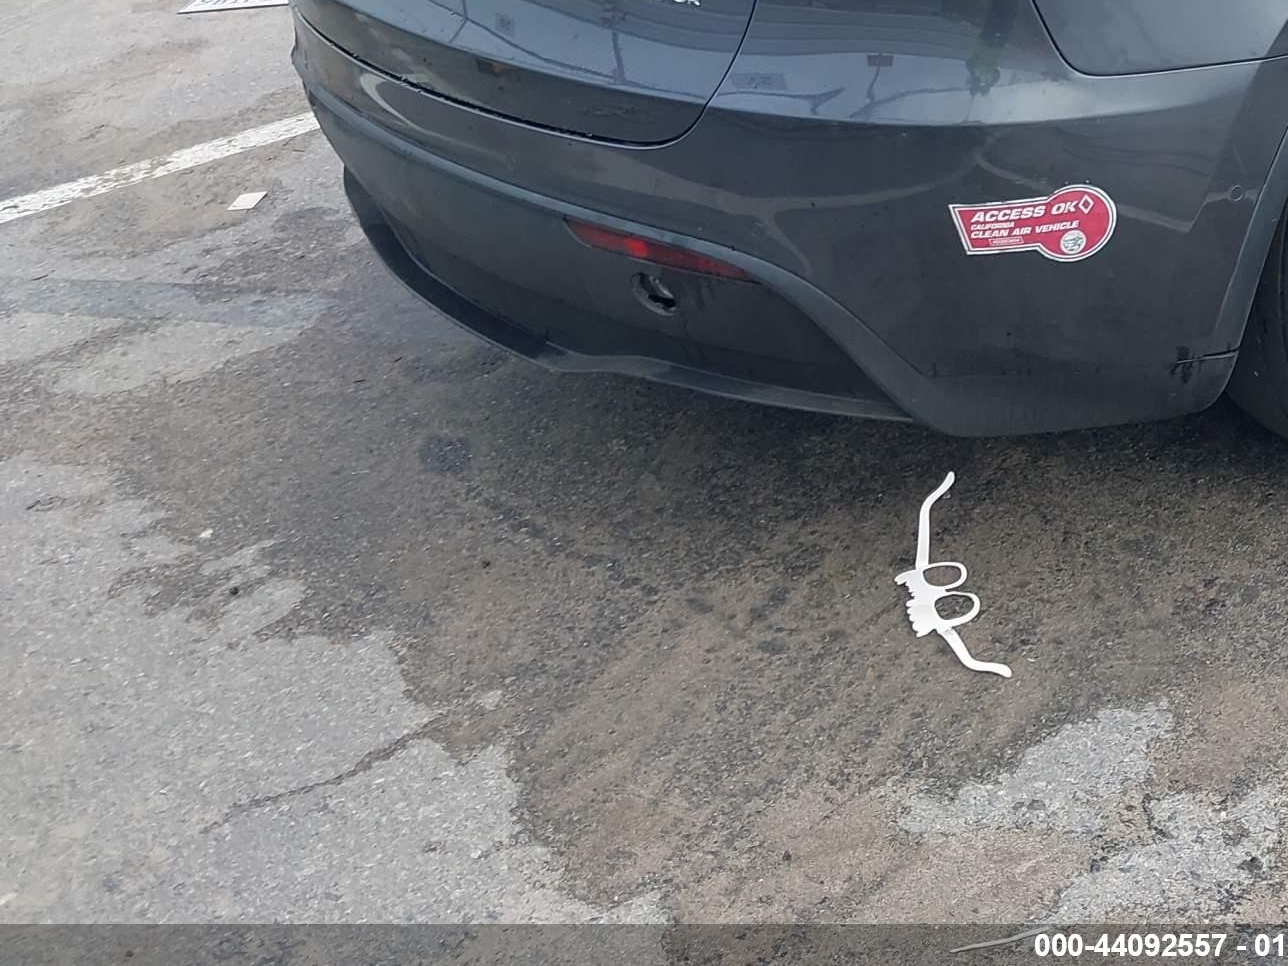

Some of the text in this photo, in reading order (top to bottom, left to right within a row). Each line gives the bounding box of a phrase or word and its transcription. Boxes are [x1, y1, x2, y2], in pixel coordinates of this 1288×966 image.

[970, 200, 1079, 223] ACCESS OK
[970, 220, 1081, 239] CLEAN AIR VEHICLE
